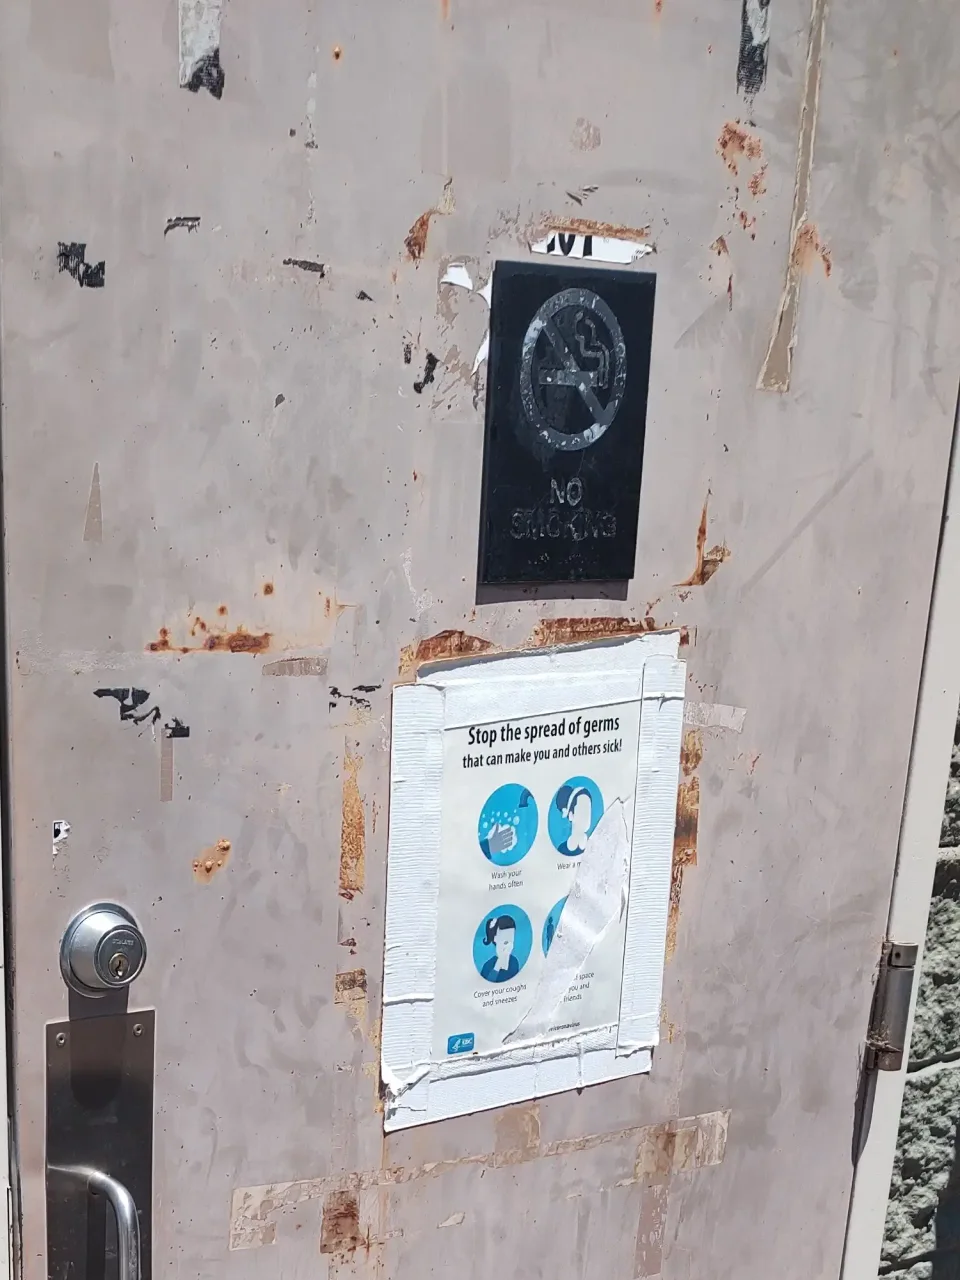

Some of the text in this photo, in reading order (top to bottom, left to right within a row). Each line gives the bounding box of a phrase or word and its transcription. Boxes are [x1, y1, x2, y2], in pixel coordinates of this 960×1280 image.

[550, 477, 582, 506] NO
[468, 716, 620, 747] Stop the spread of germs
[462, 738, 622, 769] that can make you and others sick!
[557, 862, 571, 871] Wear
[491, 869, 522, 880] Wash your
[488, 879, 524, 891] hands often
[579, 971, 595, 981] space
[473, 983, 527, 999] Cover your coughs
[568, 981, 590, 994] you and
[482, 995, 518, 1008] and sneezes
[563, 993, 582, 1003] friends
